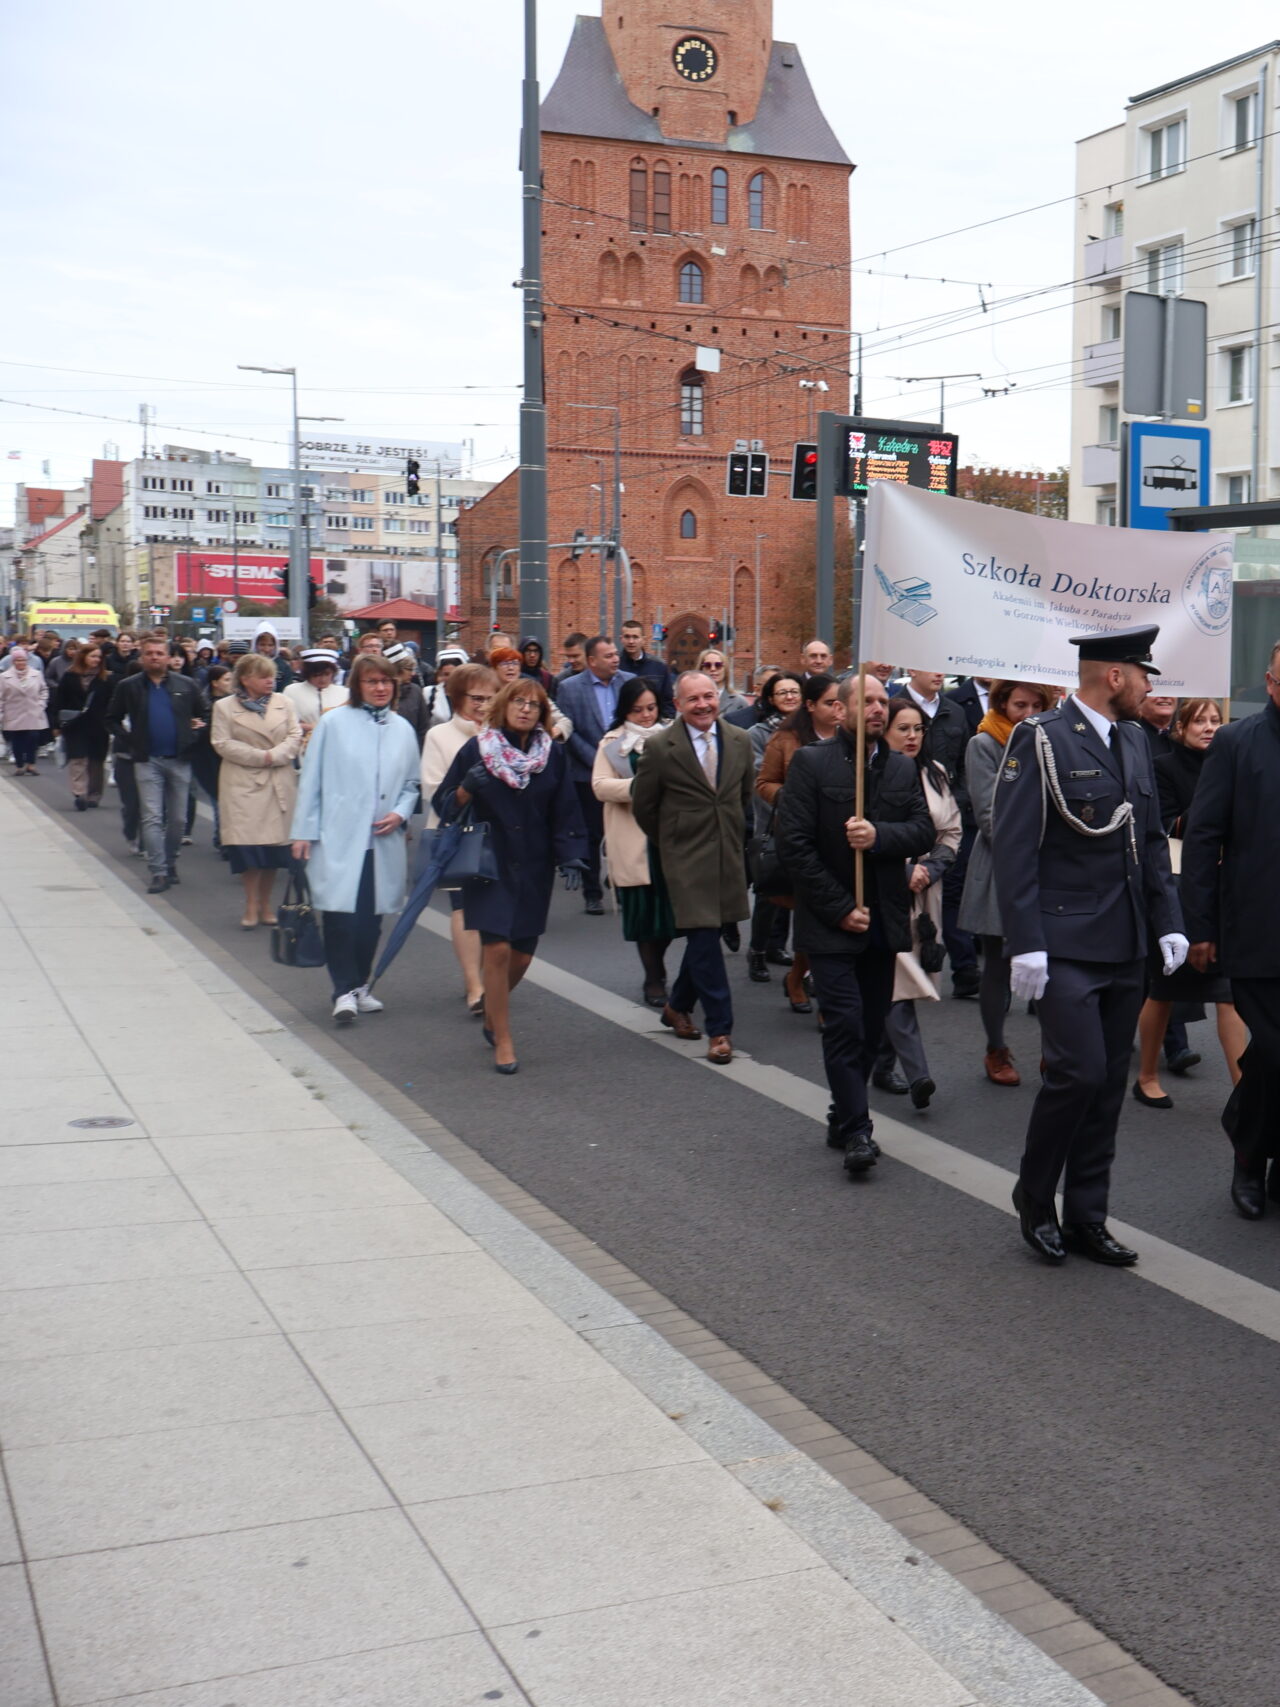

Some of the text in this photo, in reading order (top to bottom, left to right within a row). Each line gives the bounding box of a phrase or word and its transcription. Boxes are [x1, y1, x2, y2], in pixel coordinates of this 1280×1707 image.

[207, 564, 288, 579] STEMA
[962, 553, 1171, 604] Szkoła Doktorska
[992, 590, 1032, 606] Akademii
[1049, 600, 1081, 616] Jakuba
[1003, 608, 1011, 617] w
[1013, 608, 1053, 625] Gorzowie
[955, 655, 1185, 687] pedagogika językoznawstw echaniczna
